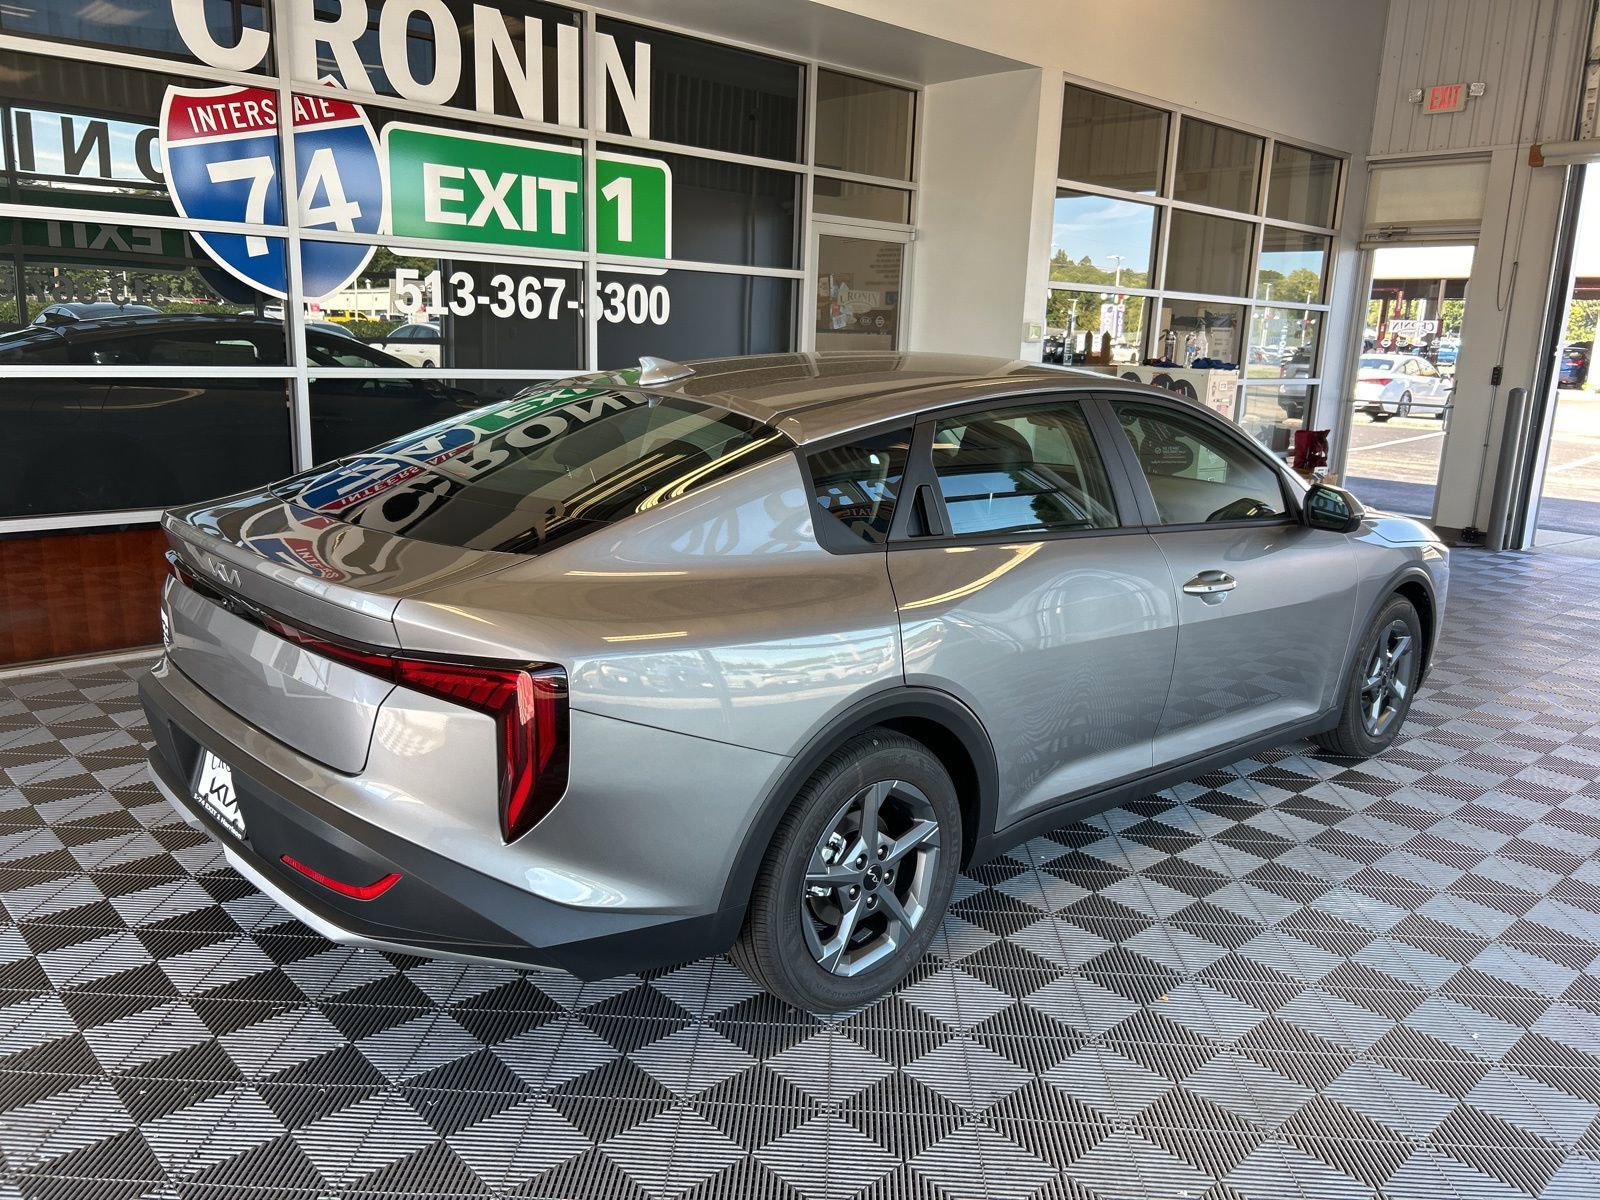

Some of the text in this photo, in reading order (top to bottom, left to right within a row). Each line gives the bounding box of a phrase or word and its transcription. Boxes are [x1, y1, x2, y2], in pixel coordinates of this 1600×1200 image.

[171, 0, 651, 139] CRONIN
[1430, 85, 1462, 110] EXIT
[187, 96, 335, 133] INTERSATE
[206, 148, 362, 257] 74
[423, 162, 632, 242] EXIT 1
[208, 557, 242, 589] KIA
